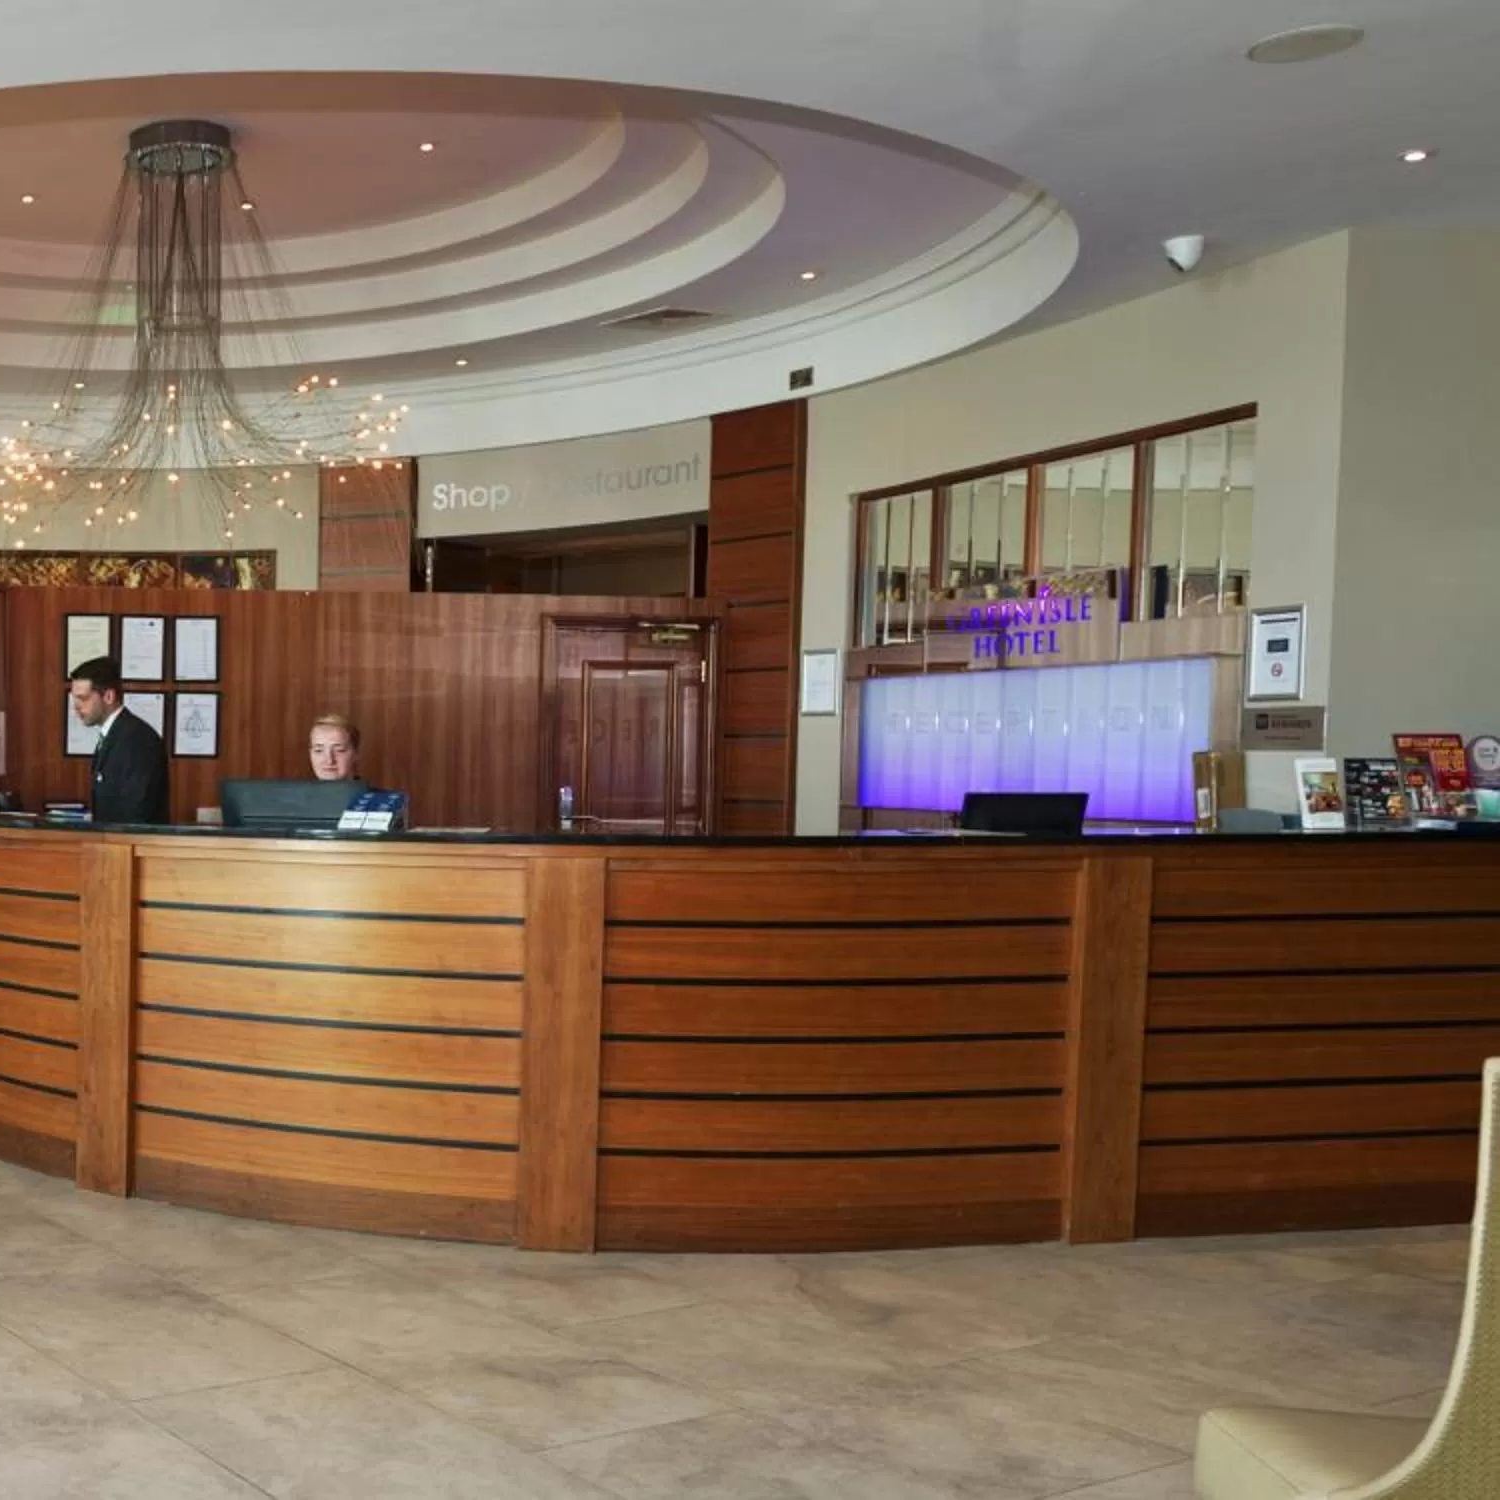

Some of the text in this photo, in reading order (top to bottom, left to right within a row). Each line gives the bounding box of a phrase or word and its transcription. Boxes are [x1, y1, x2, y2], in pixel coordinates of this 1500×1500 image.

[432, 482, 510, 512] Shop
[544, 453, 702, 497] staurant
[974, 629, 1060, 659] HOTEL
